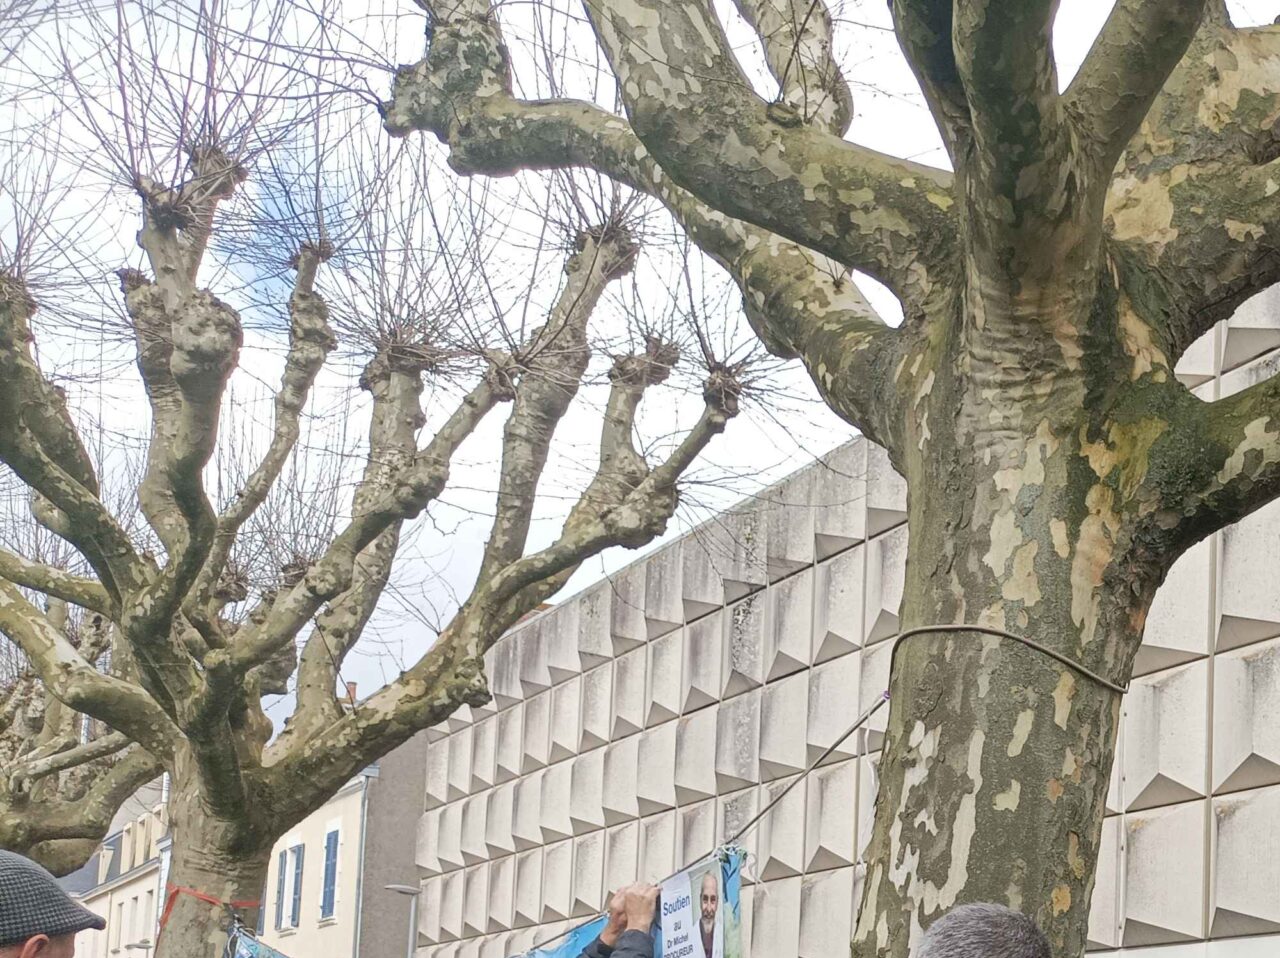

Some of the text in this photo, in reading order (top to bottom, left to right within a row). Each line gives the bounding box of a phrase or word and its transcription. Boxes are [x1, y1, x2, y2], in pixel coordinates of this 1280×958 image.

[663, 895, 690, 916] Soutien
[673, 920, 682, 931] au
[667, 933, 689, 949] Dr Michel
